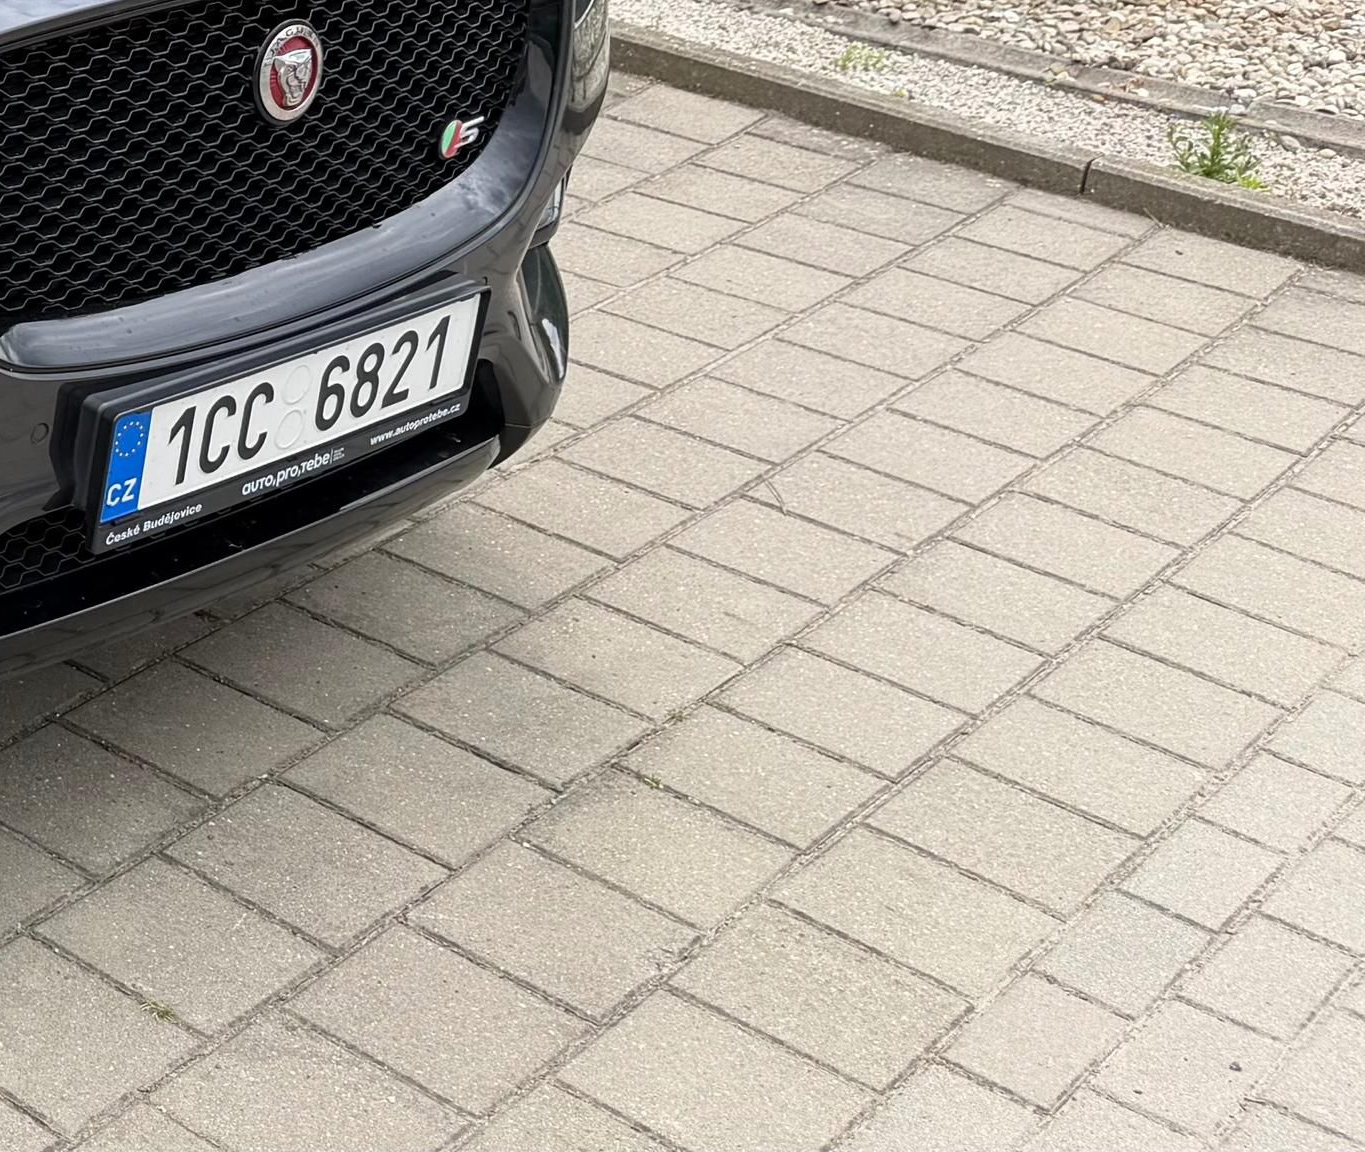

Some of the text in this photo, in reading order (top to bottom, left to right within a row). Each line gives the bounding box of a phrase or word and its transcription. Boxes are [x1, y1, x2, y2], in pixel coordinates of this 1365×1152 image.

[168, 314, 451, 486] 1CC 6821
[370, 403, 461, 446] www.autoprotebe.cz
[106, 477, 138, 507] CZ
[105, 503, 203, 546] České Budějovice
